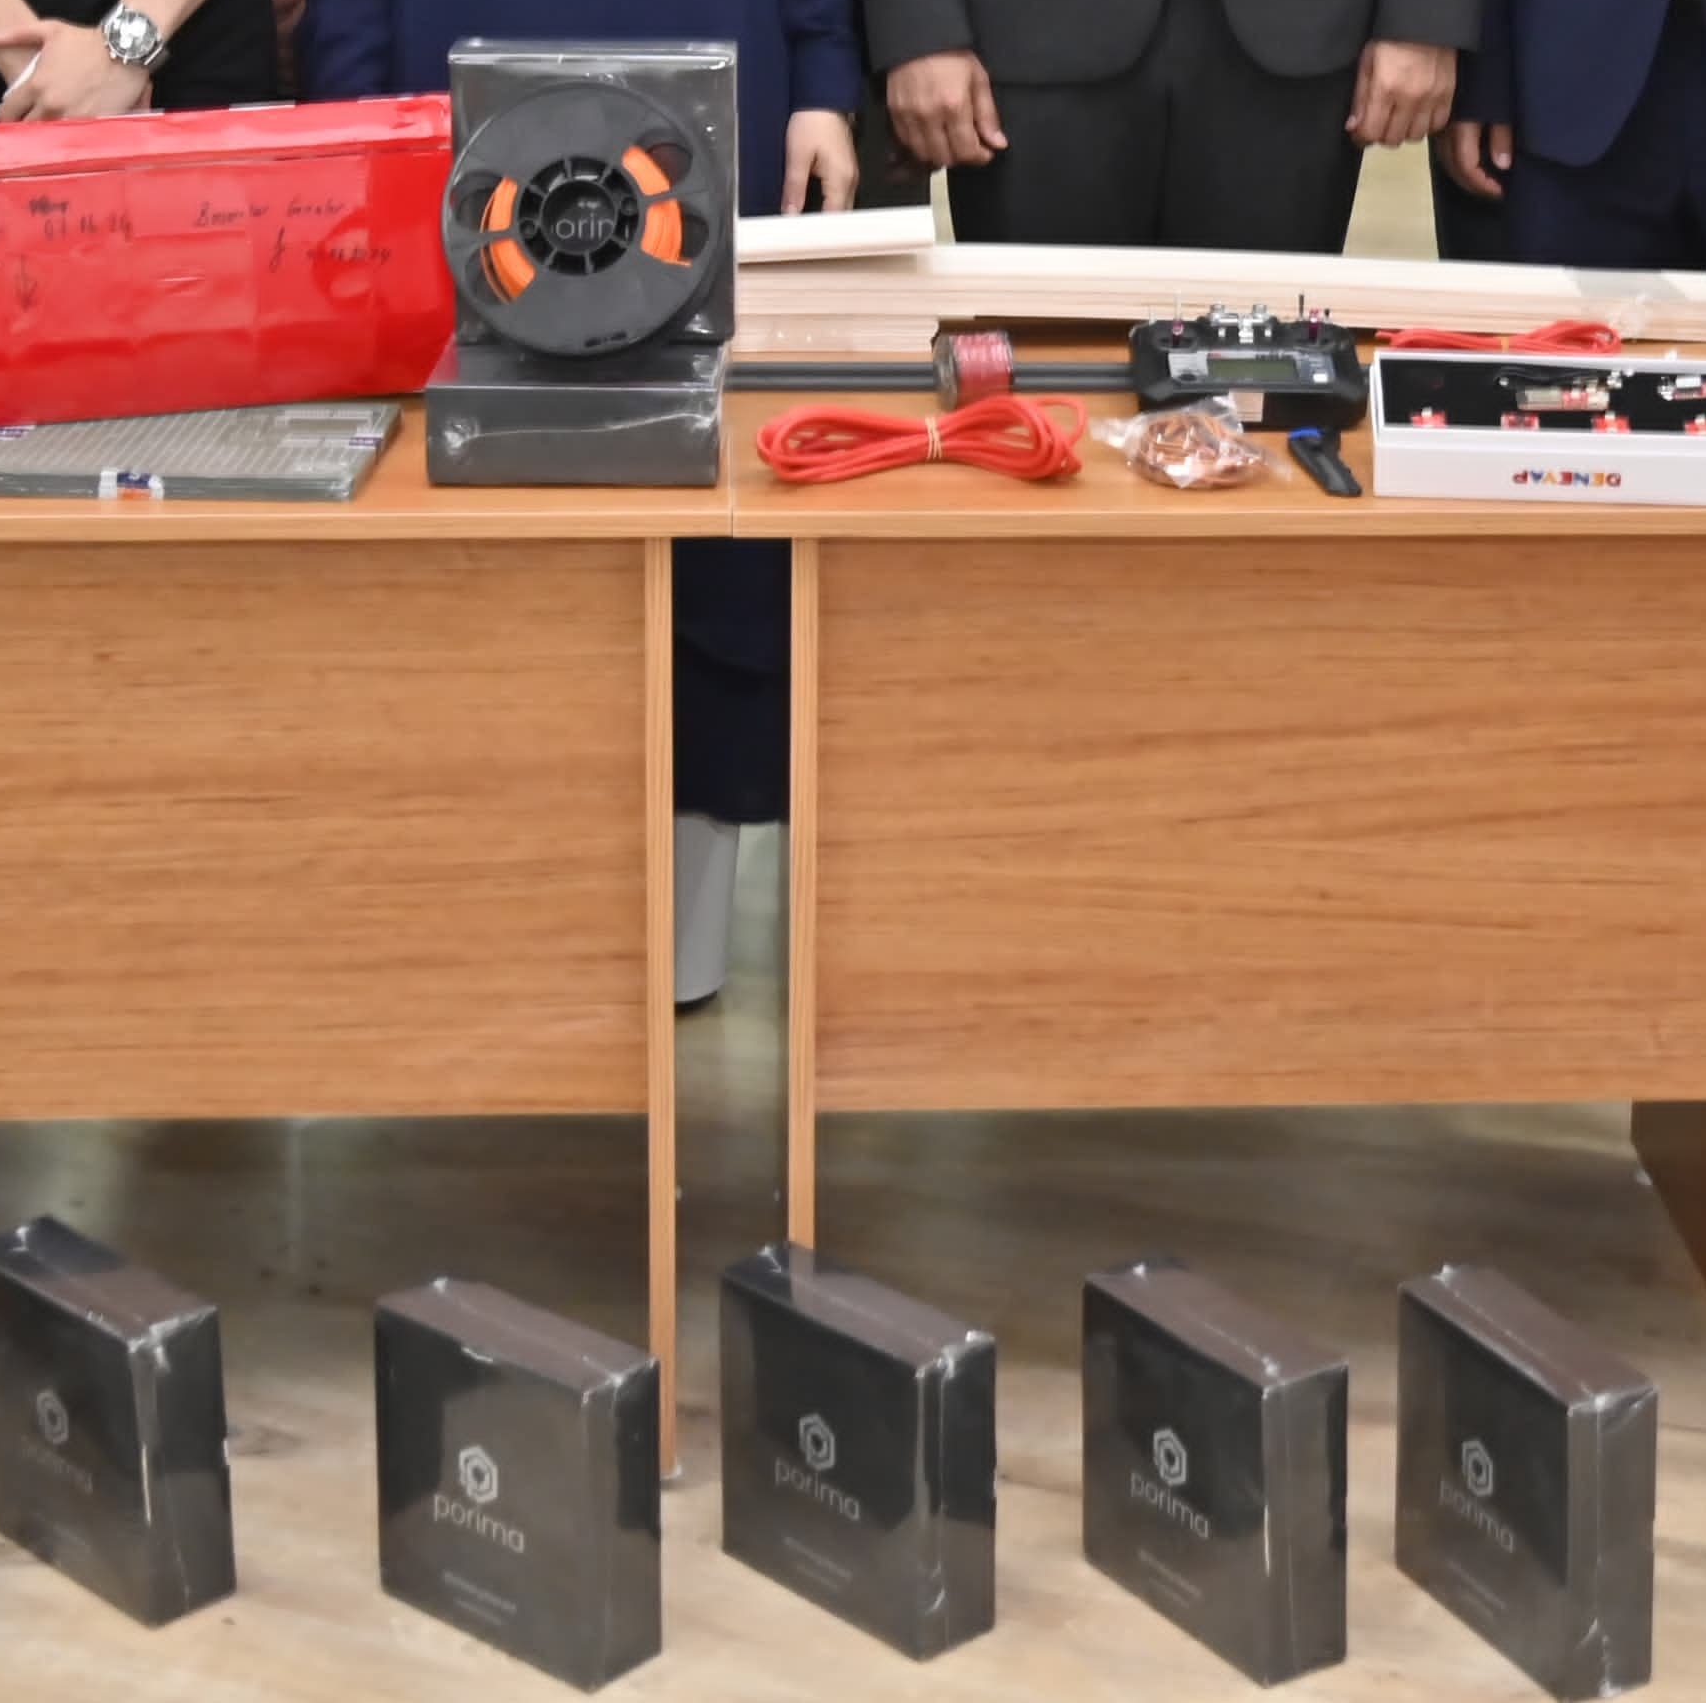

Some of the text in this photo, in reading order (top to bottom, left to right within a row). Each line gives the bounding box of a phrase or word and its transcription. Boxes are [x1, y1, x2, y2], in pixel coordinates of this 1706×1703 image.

[1512, 470, 1622, 488] DENEYAP
[775, 1456, 860, 1521] porima
[1130, 1471, 1209, 1540] porima
[434, 1494, 525, 1554] porima
